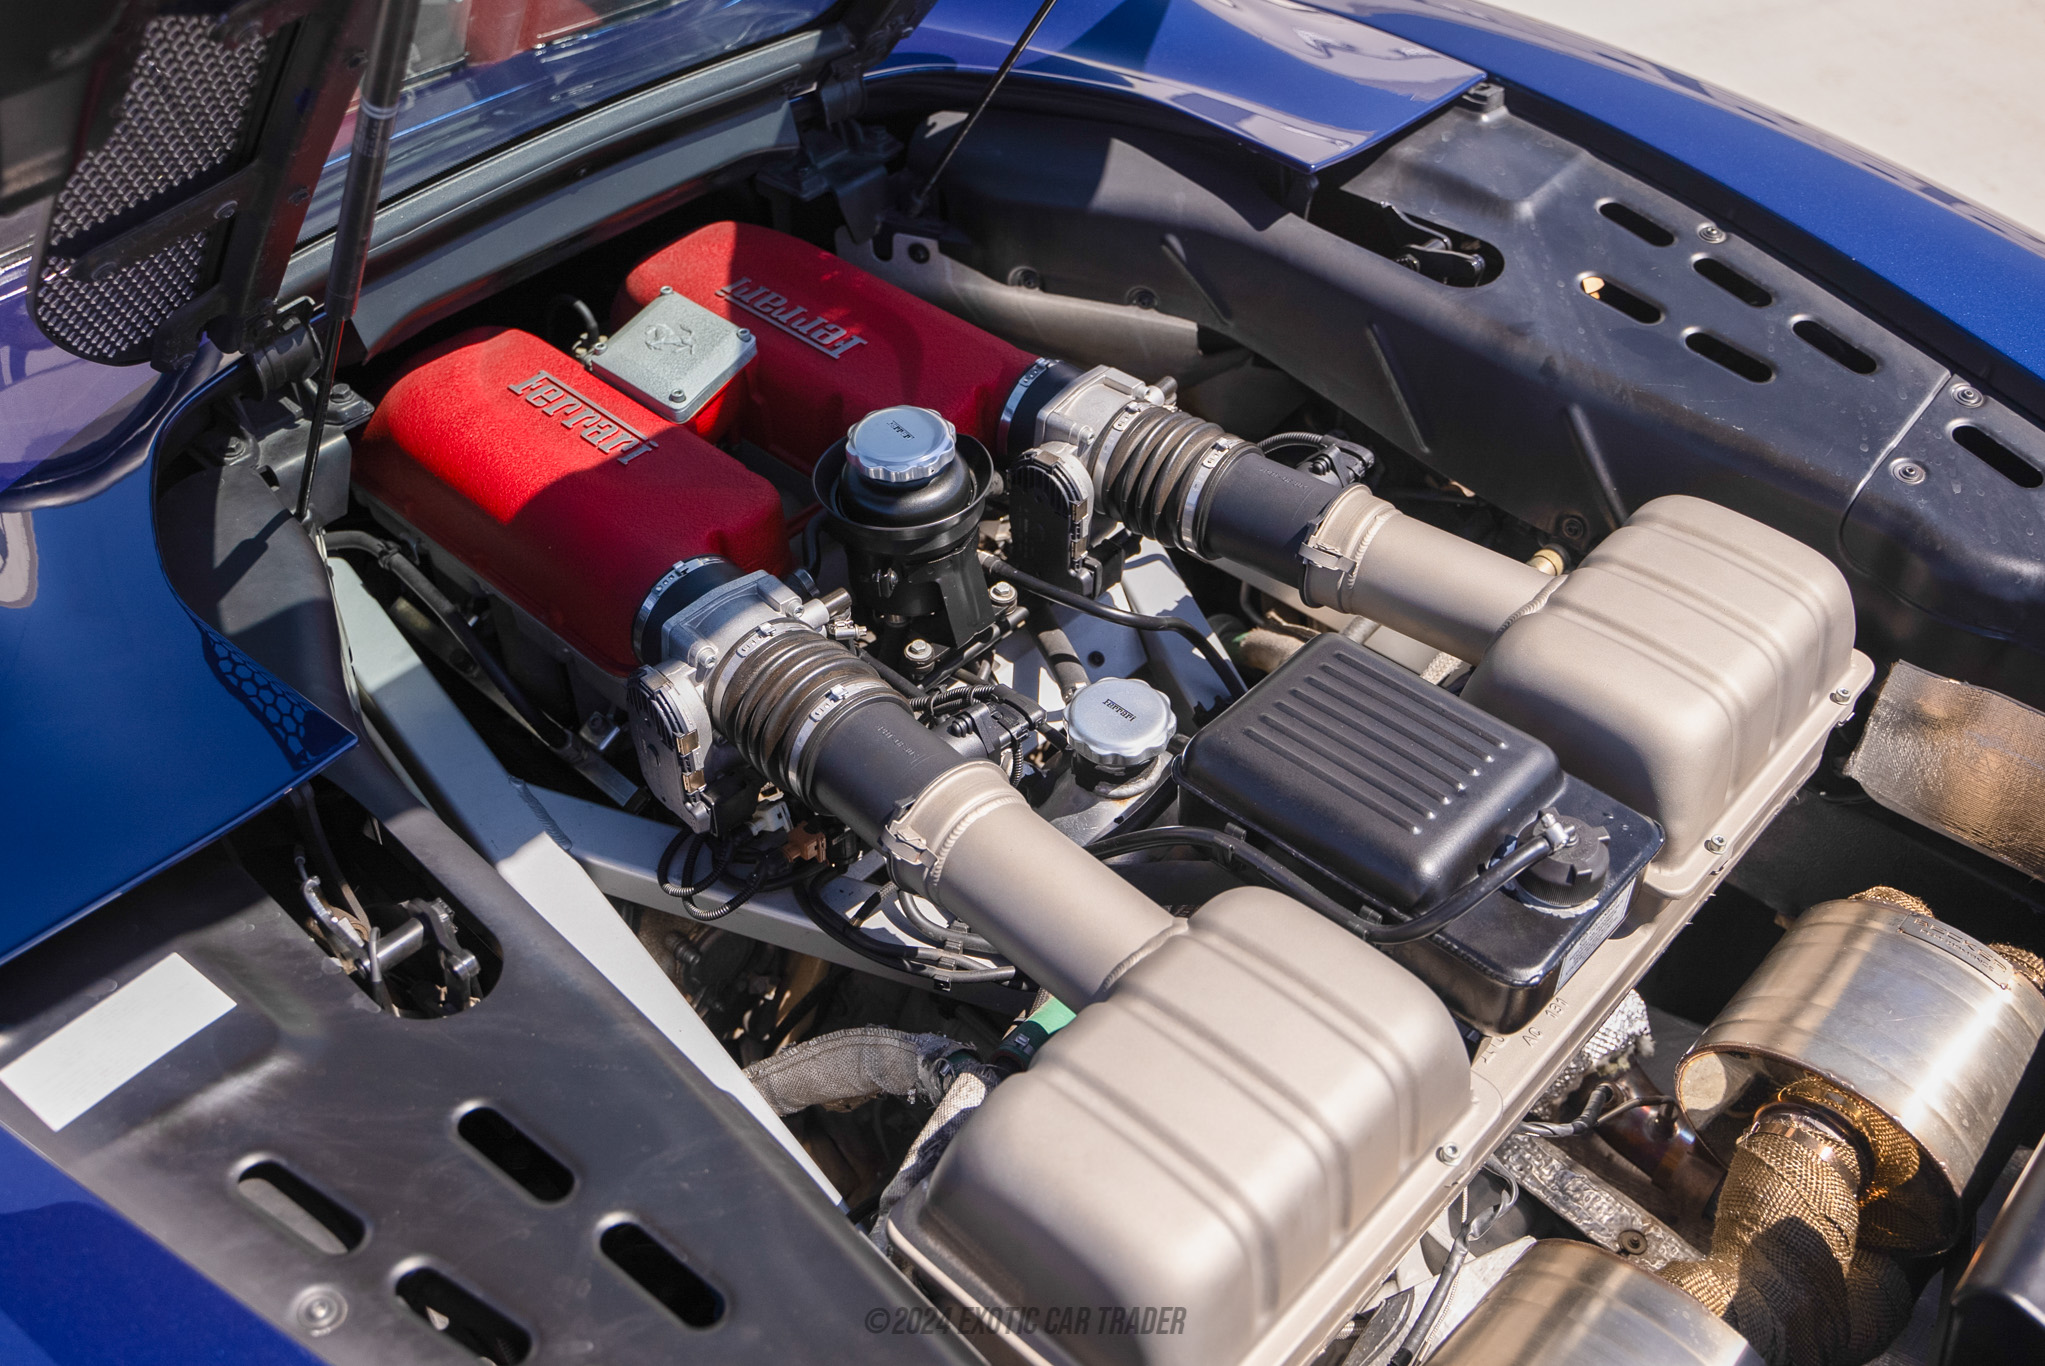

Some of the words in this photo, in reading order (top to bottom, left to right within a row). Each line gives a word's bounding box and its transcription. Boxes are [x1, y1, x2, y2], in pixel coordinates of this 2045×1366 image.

[714, 276, 868, 359] Ferrari
[507, 370, 659, 465] Ferrari
[1102, 698, 1136, 722] Ferrari
